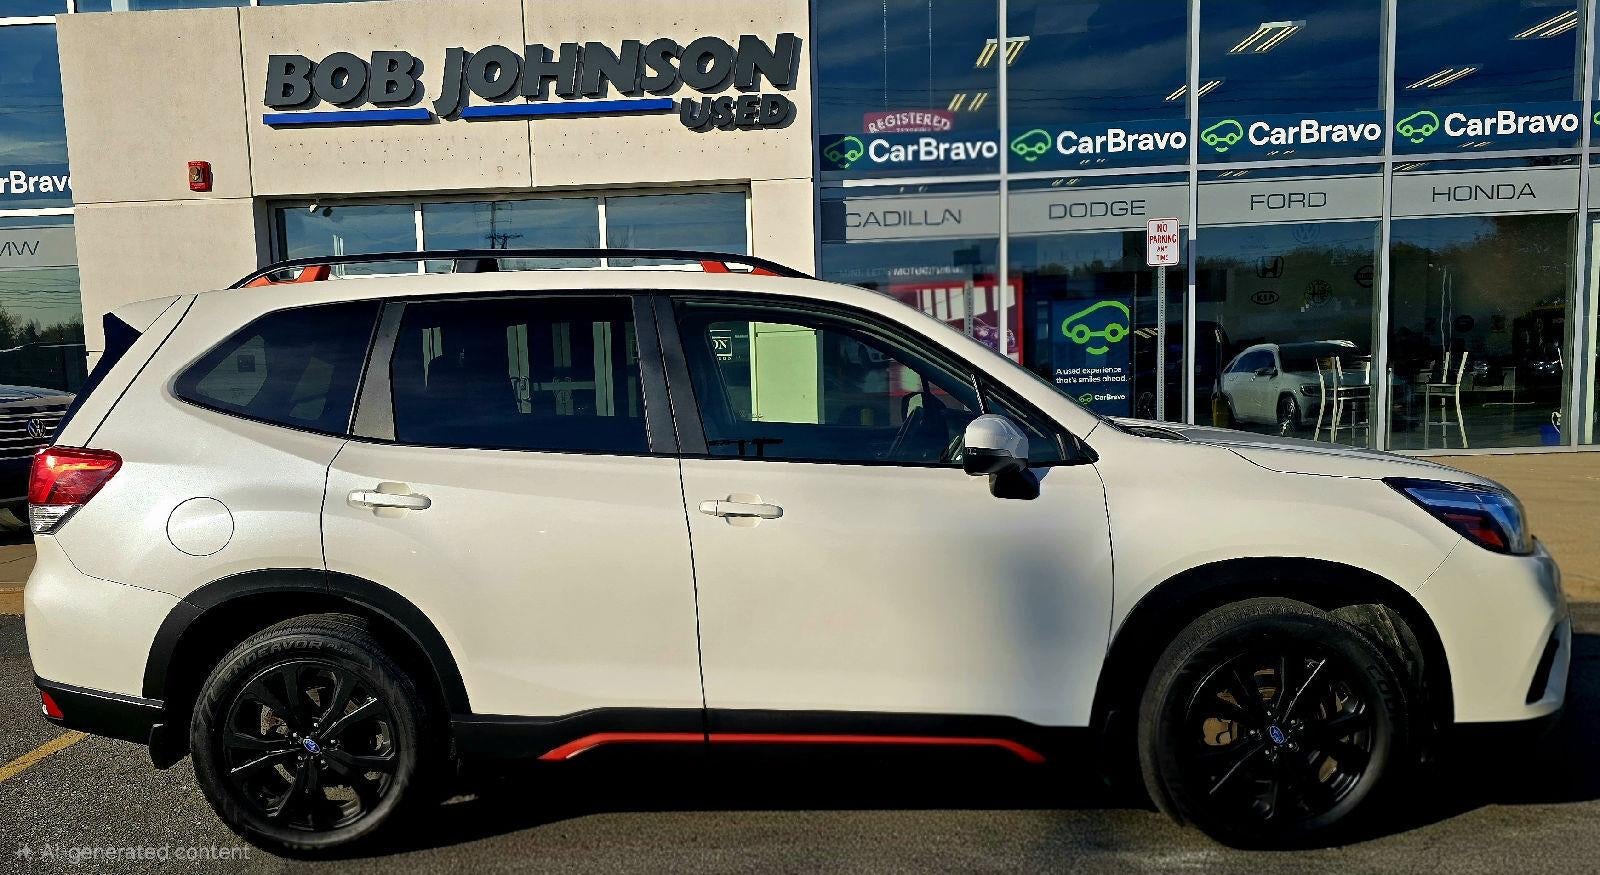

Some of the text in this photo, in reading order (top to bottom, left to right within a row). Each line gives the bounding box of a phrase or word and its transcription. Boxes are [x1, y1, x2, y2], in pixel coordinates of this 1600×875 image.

[264, 33, 799, 120] BOB JOHNSON
[680, 94, 795, 131] USED
[868, 111, 951, 134] REGISTERED
[1444, 110, 1579, 137] CarBravo
[1056, 128, 1187, 155] CarBravo
[1248, 119, 1382, 146] CarBravo
[868, 137, 998, 163] CarBravo
[0, 170, 72, 194] rBrav
[1432, 182, 1537, 203] HONDA
[1049, 199, 1146, 220] DODGE
[1250, 191, 1327, 211] FORD
[1149, 234, 1176, 244] PARKING
[1156, 224, 1168, 232] NO
[1055, 374, 1128, 384] that's smiles ahead.
[1063, 367, 1081, 375] used
[1081, 366, 1122, 375] experience
[1094, 393, 1126, 401] CarBravo
